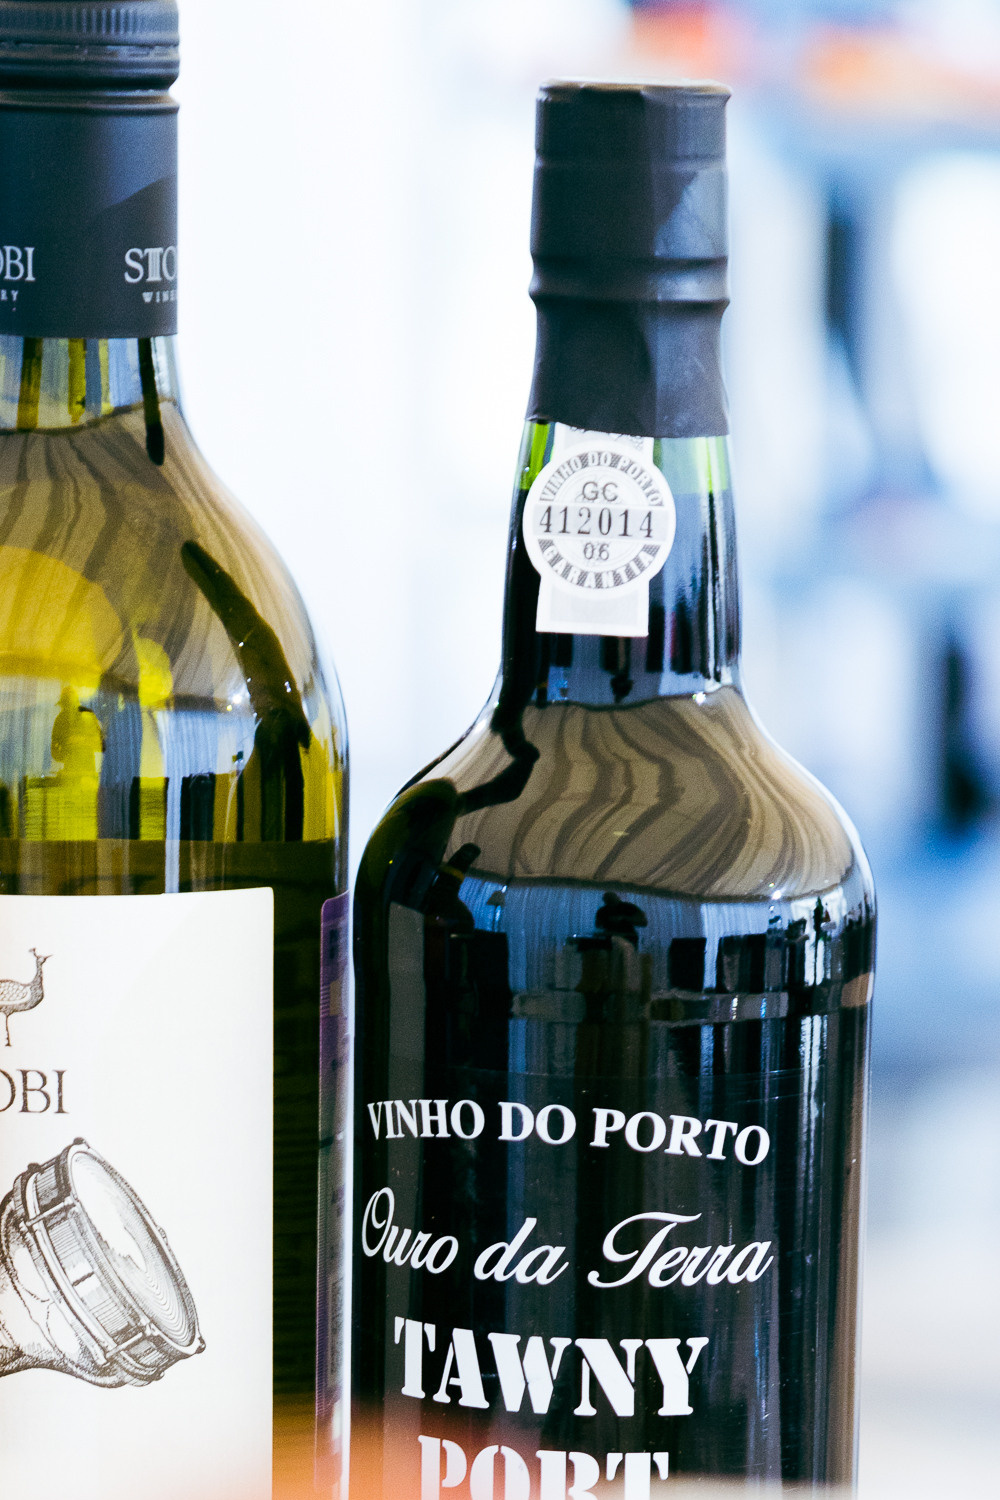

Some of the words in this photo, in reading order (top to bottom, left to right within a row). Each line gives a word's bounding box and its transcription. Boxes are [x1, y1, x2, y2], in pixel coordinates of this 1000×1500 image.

[124, 246, 177, 283] STO
[541, 456, 582, 502] VINHO
[588, 450, 612, 467] DO
[621, 455, 661, 503] PORTO
[582, 481, 618, 502] GC
[539, 505, 654, 538] 412014
[367, 1099, 485, 1140] VINHO
[498, 1101, 576, 1145] DO
[589, 1107, 771, 1166] PORTO
[361, 1187, 459, 1274] Ouro
[474, 1217, 569, 1285] da
[587, 1211, 774, 1288] Terra
[394, 1316, 709, 1417] TAWNY
